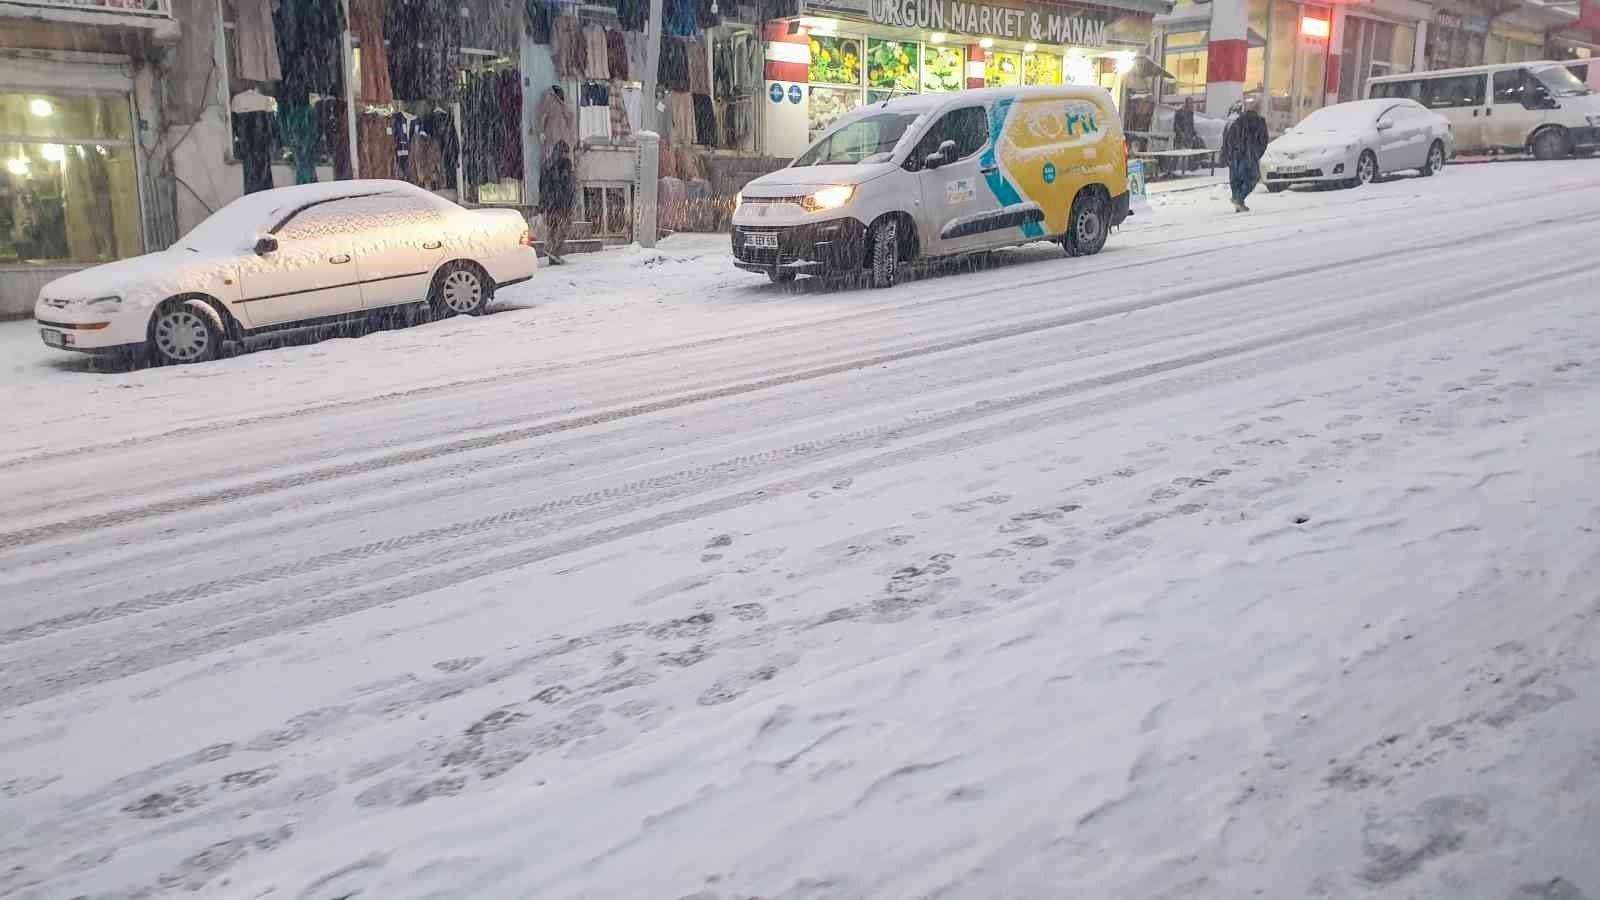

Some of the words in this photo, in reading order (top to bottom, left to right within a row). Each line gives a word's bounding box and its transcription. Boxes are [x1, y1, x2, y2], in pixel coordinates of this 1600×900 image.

[951, 4, 1025, 39] MARKET
[1030, 12, 1042, 40] &
[1047, 15, 1105, 46] MANAV
